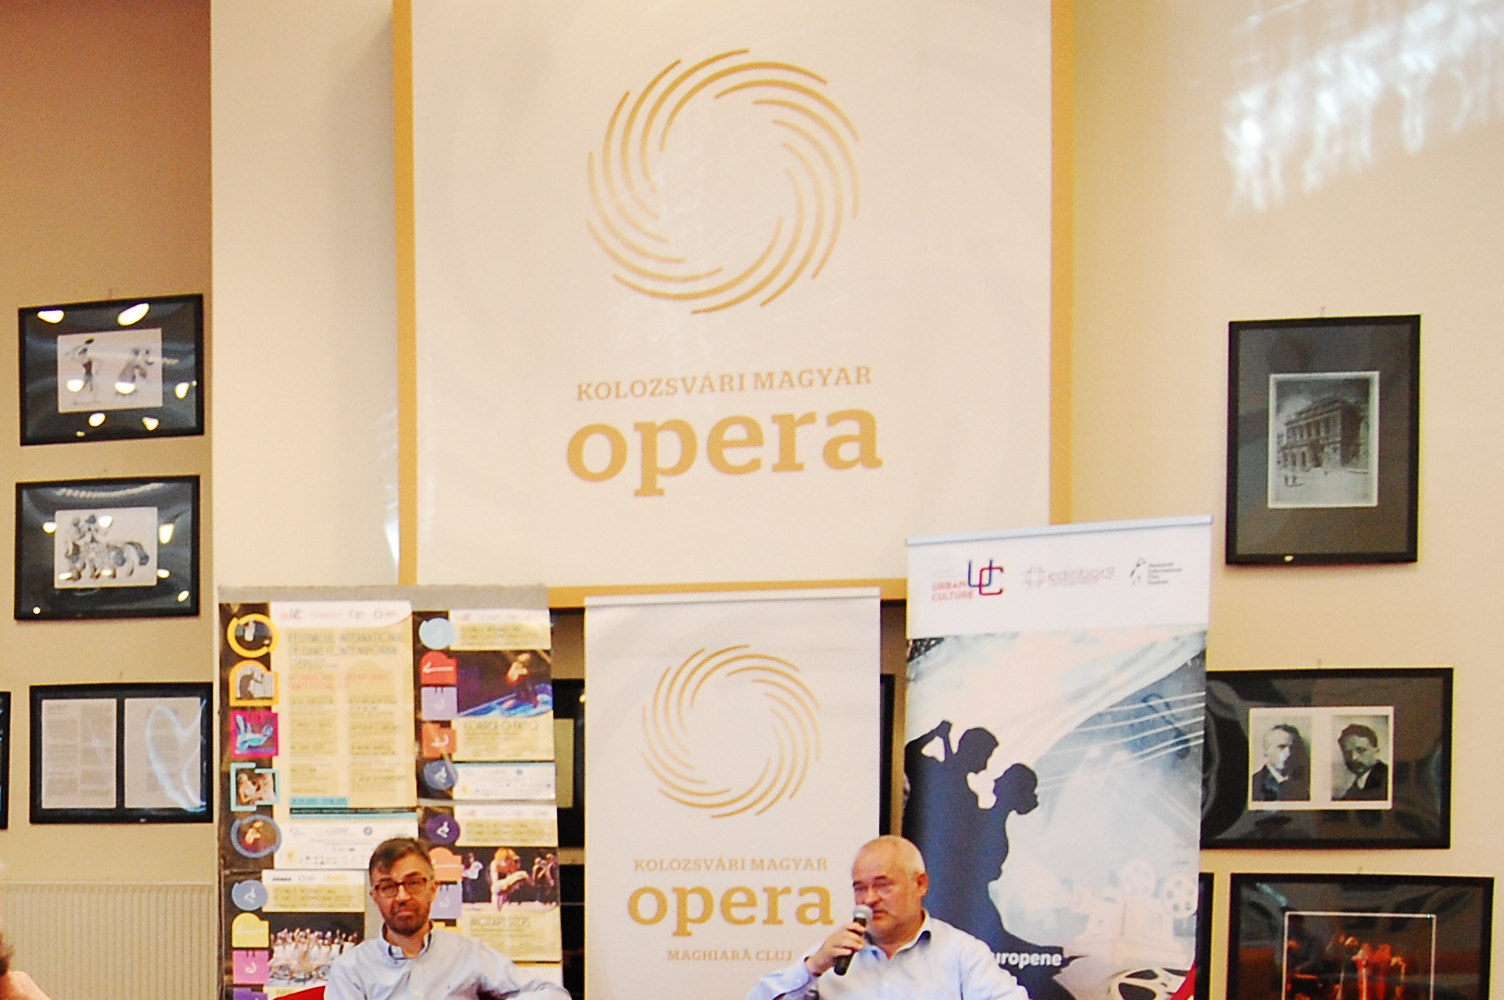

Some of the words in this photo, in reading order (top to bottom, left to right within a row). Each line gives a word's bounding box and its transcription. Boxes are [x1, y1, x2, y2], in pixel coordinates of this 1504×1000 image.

[577, 371, 746, 401] KOLOZSVÁRI
[753, 366, 873, 391] MAGYAR
[567, 409, 884, 497] opera
[634, 857, 746, 872] KOLOZSVÁRI
[750, 857, 829, 871] MAGYAR
[627, 884, 836, 937] opera
[755, 949, 794, 962] CLUJ
[996, 952, 1063, 969] ropene
